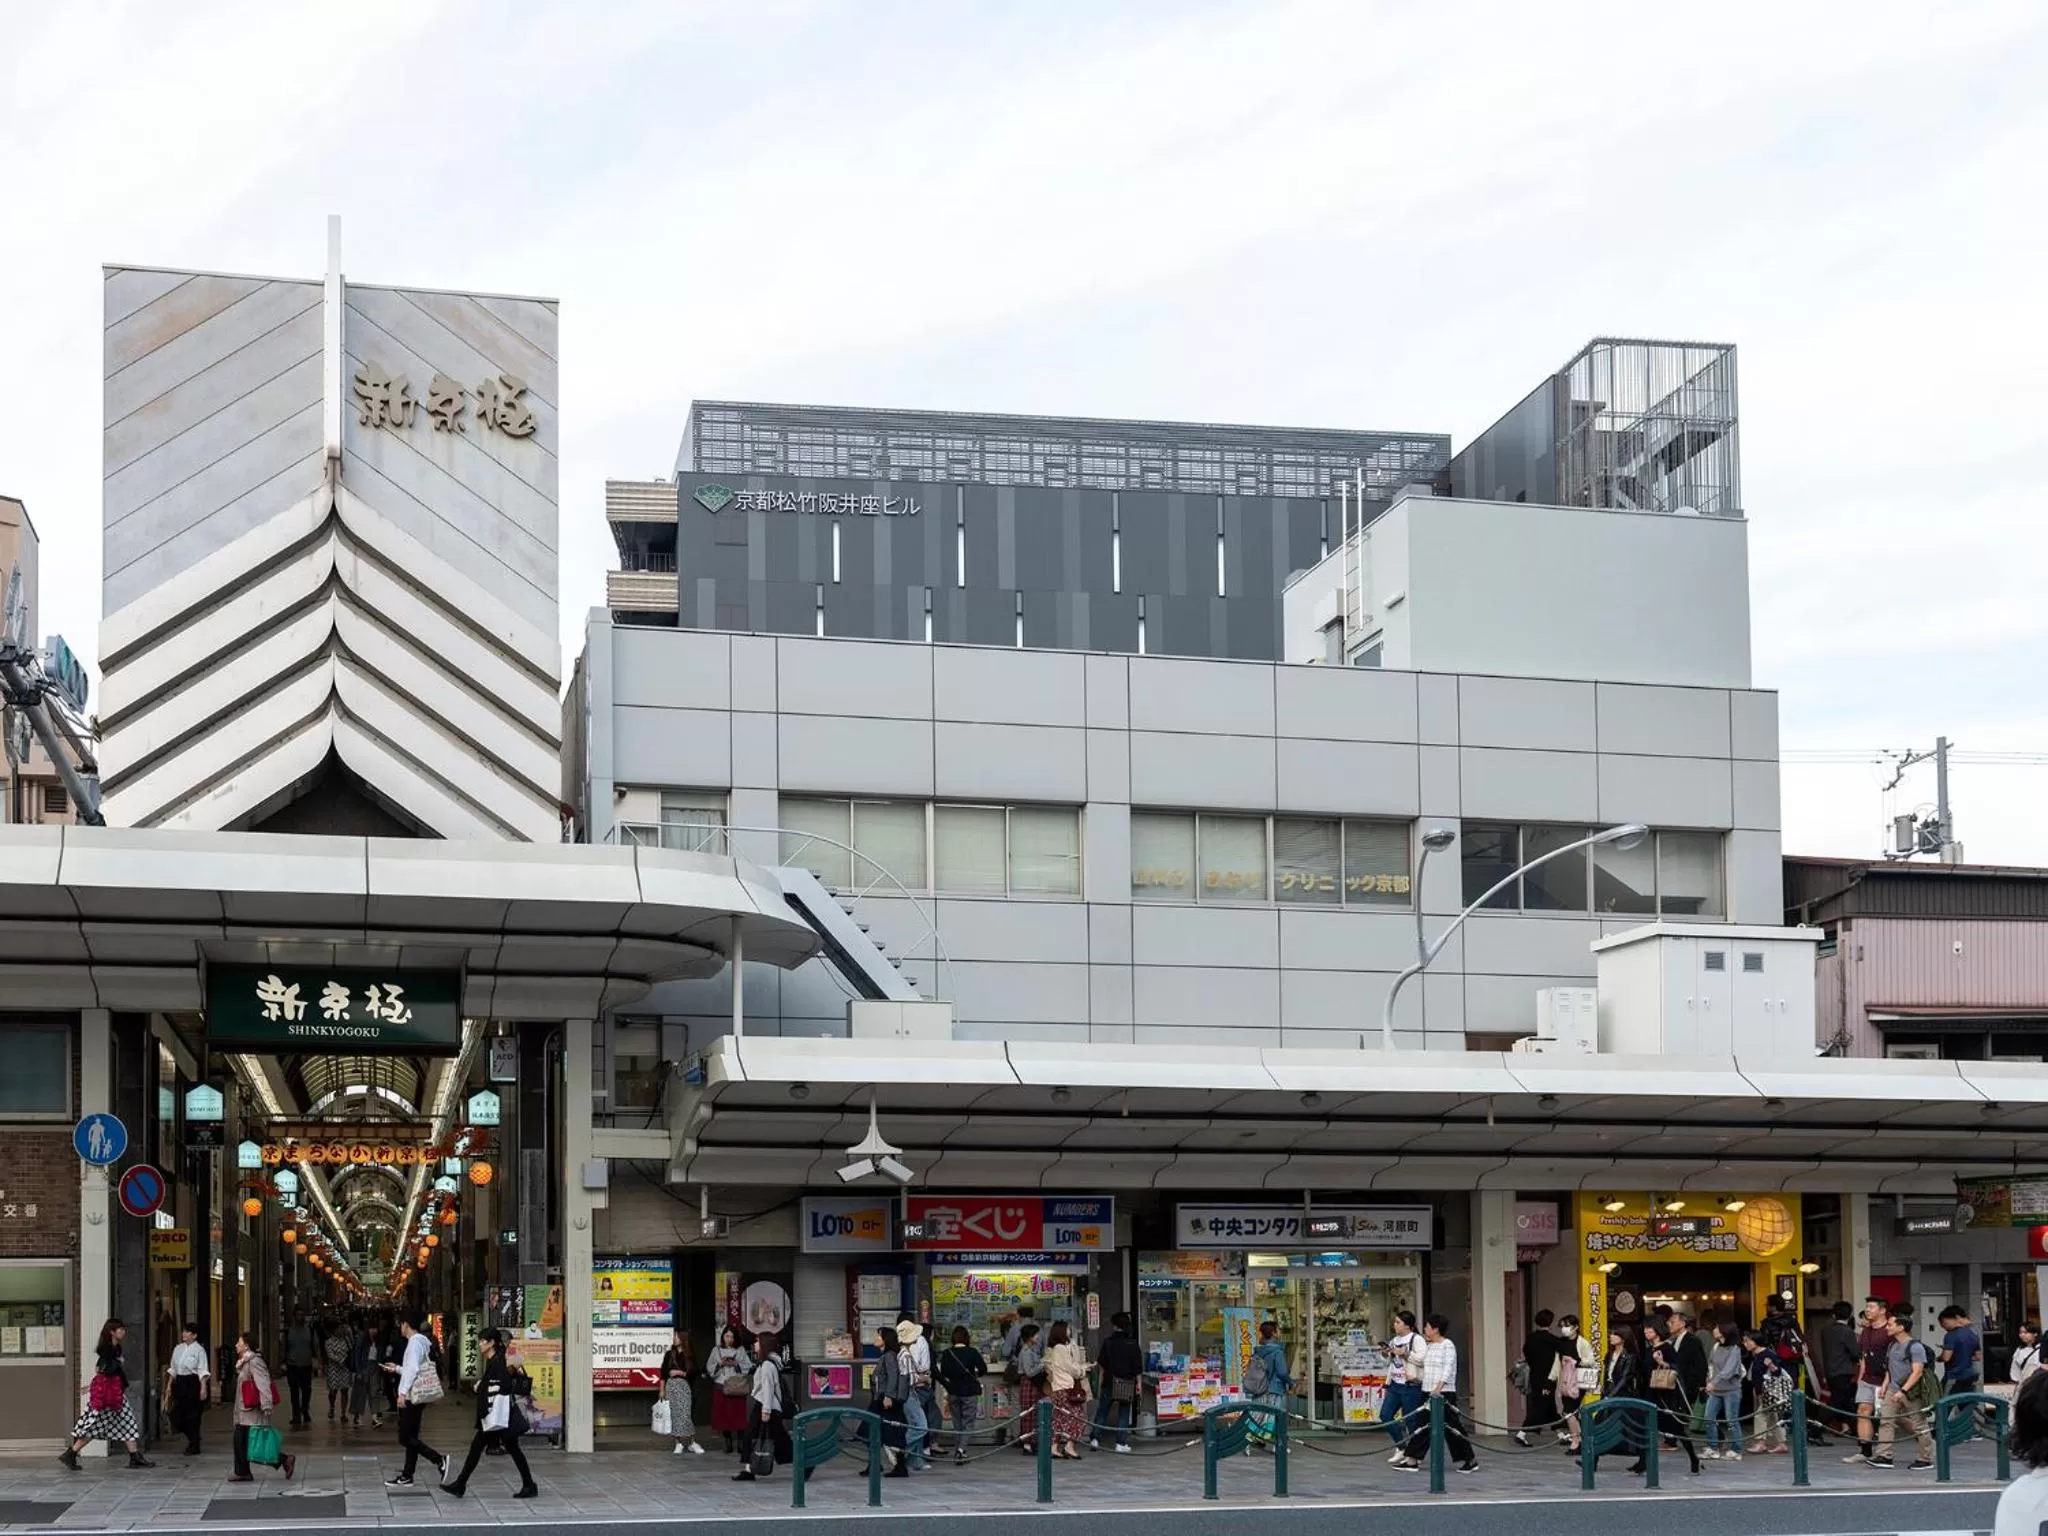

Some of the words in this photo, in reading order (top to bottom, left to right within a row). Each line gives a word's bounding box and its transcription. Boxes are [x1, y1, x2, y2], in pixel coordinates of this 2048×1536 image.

[354, 360, 537, 439] 新京極
[733, 489, 922, 516] 京都松竹阪井座ビル
[255, 974, 413, 1025] 新京極
[287, 1025, 380, 1038] SHINKYOGOKU
[811, 1211, 854, 1238] LOTO
[924, 1206, 1027, 1241] 宝くじ
[1208, 1217, 1300, 1237] 中央コンタク
[1383, 1220, 1418, 1233] 河原町
[1055, 1228, 1082, 1245] LOTO
[592, 1342, 626, 1354] Smart
